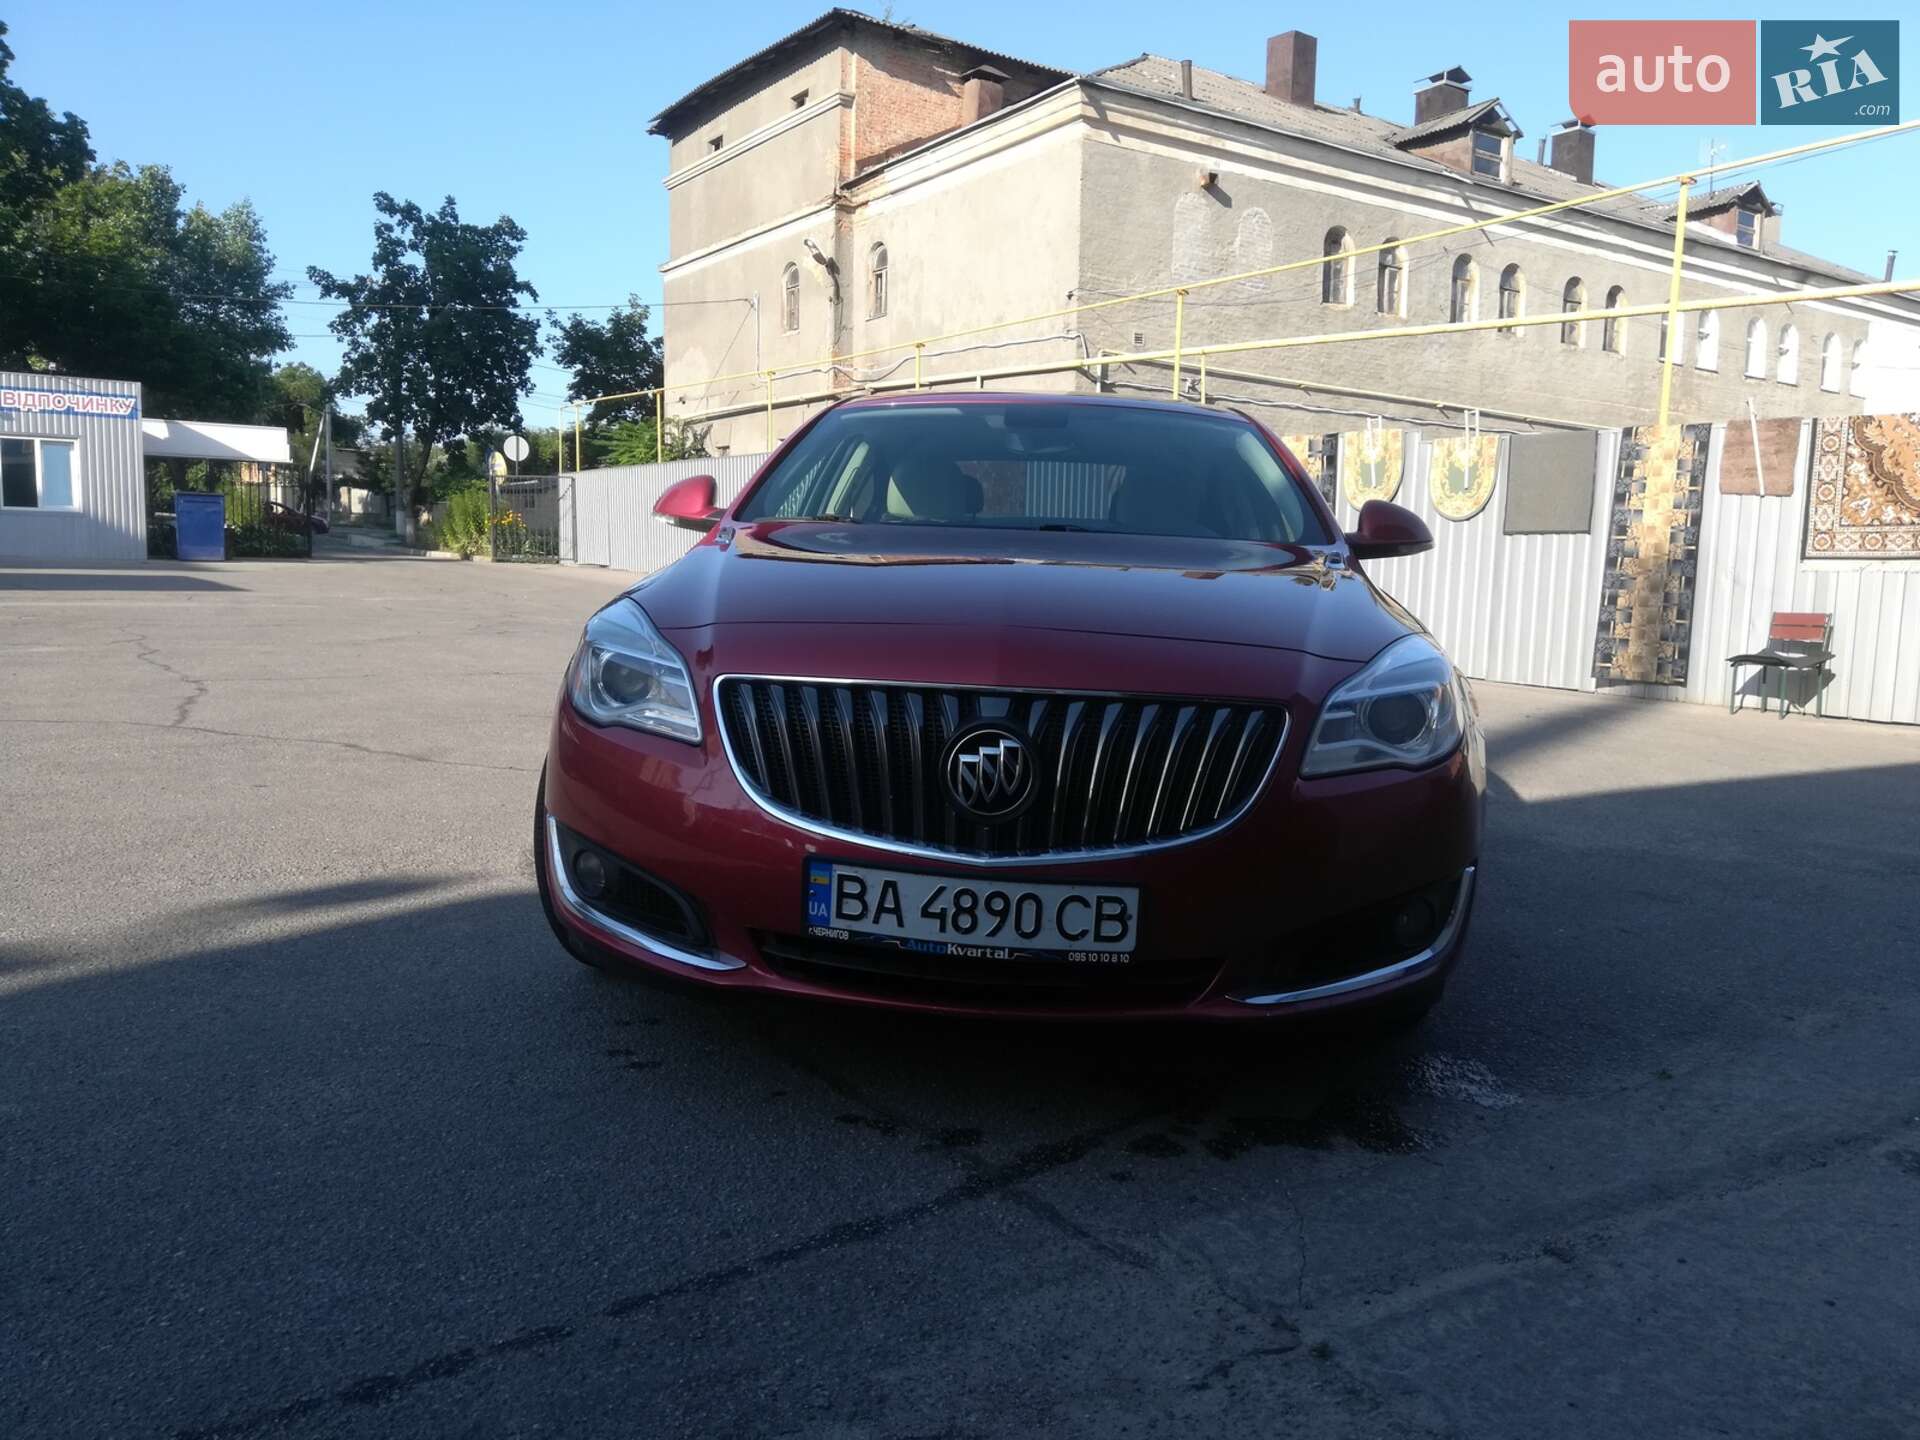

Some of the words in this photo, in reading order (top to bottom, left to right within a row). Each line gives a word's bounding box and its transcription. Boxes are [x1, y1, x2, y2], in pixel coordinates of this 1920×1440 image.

[2, 390, 136, 414] ВІДПОЧИНКУ
[808, 901, 828, 917] UA
[919, 884, 1043, 940] 4890
